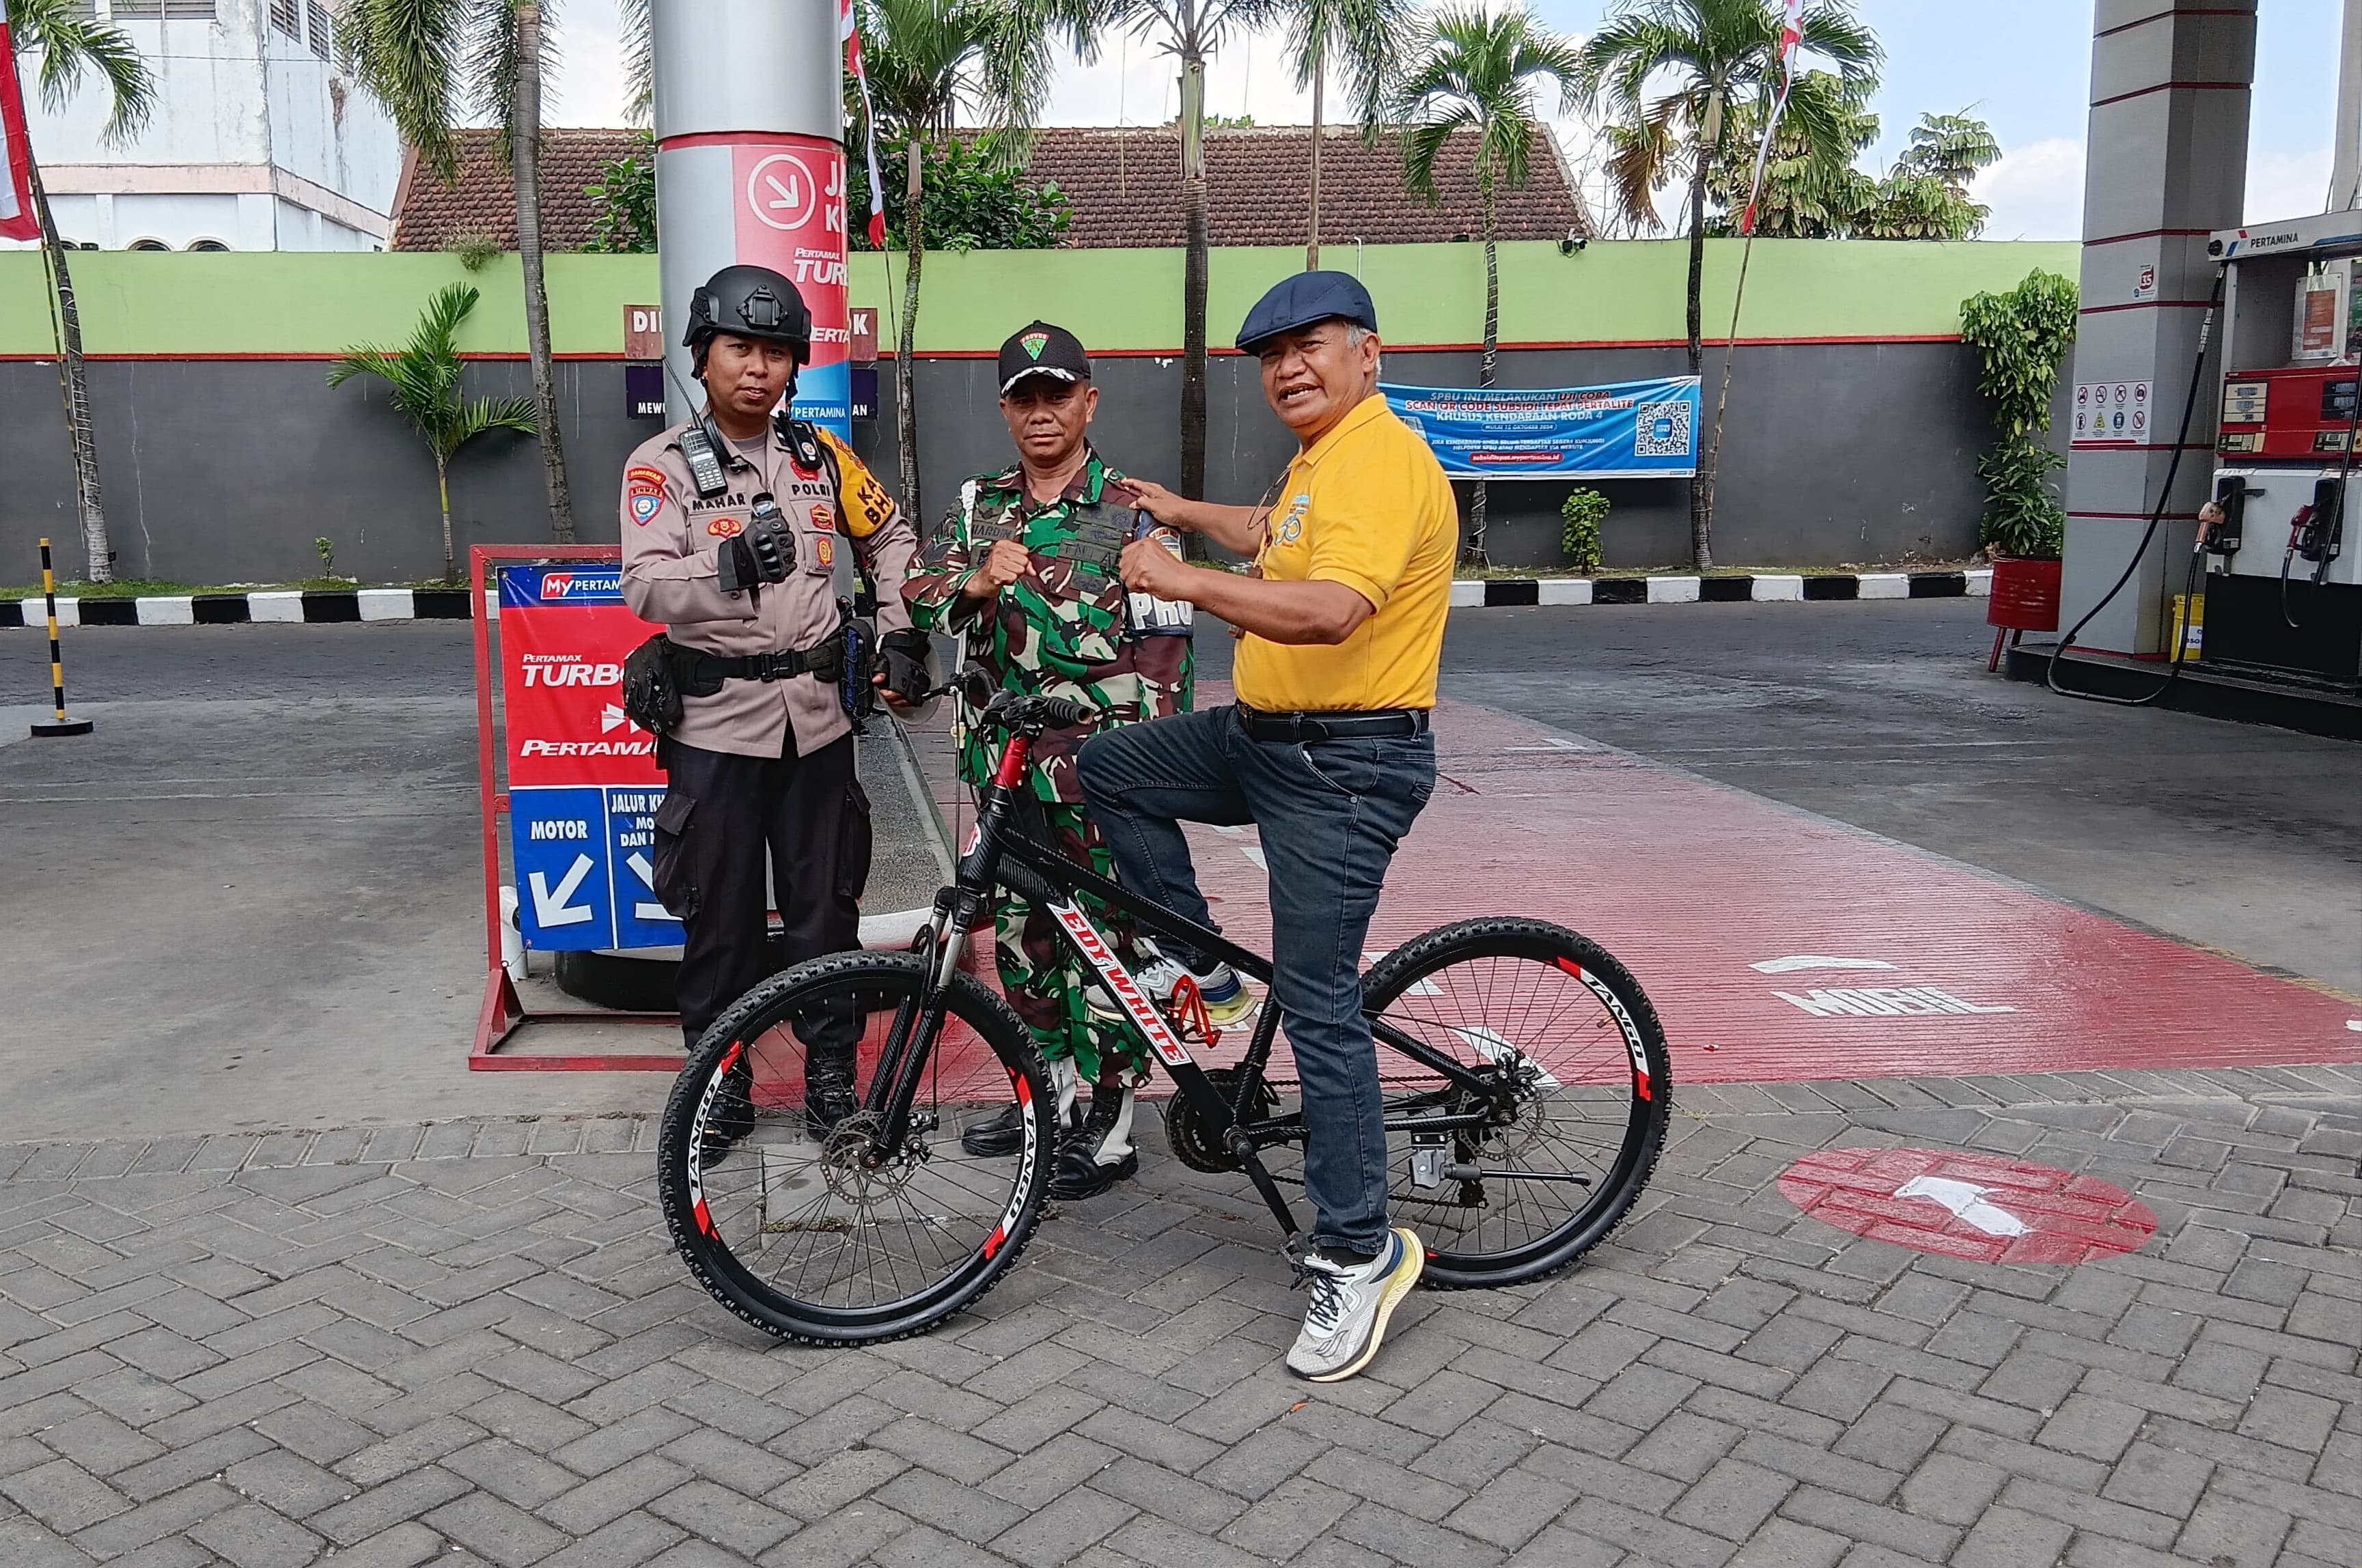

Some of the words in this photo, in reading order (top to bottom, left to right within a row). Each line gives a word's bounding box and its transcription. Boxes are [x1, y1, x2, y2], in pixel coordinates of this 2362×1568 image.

[2250, 233, 2299, 249] PERTAMINA
[794, 247, 841, 261] PERTAMAX
[810, 325, 851, 344] ERTA
[1430, 392, 1460, 402] SPBU
[1464, 393, 1482, 402] INI
[1484, 393, 1555, 402] MELAKUKAN
[1559, 392, 1576, 401] UJI
[1579, 391, 1611, 401] COBA
[852, 404, 868, 417] AN
[1406, 400, 1436, 411] SCAN
[1459, 402, 1491, 412] CODE
[1493, 402, 1538, 412] SUBSIDI
[1542, 402, 1575, 411] TEPAT
[1577, 400, 1634, 411] PERTALITE
[1436, 412, 1482, 421] KHUSUS
[1486, 412, 1557, 422] KENDARAAN
[1560, 411, 1593, 421] RODA
[1596, 411, 1604, 420] 4
[791, 484, 831, 497] POLRI
[523, 654, 583, 663] PERTAMAX
[612, 794, 646, 813] JALUR
[530, 820, 588, 840] MOTOR
[620, 832, 646, 848] DAN
[1589, 977, 1645, 1061] TANGO
[689, 1083, 717, 1192] TANGO
[1010, 1114, 1038, 1220] TANGO
